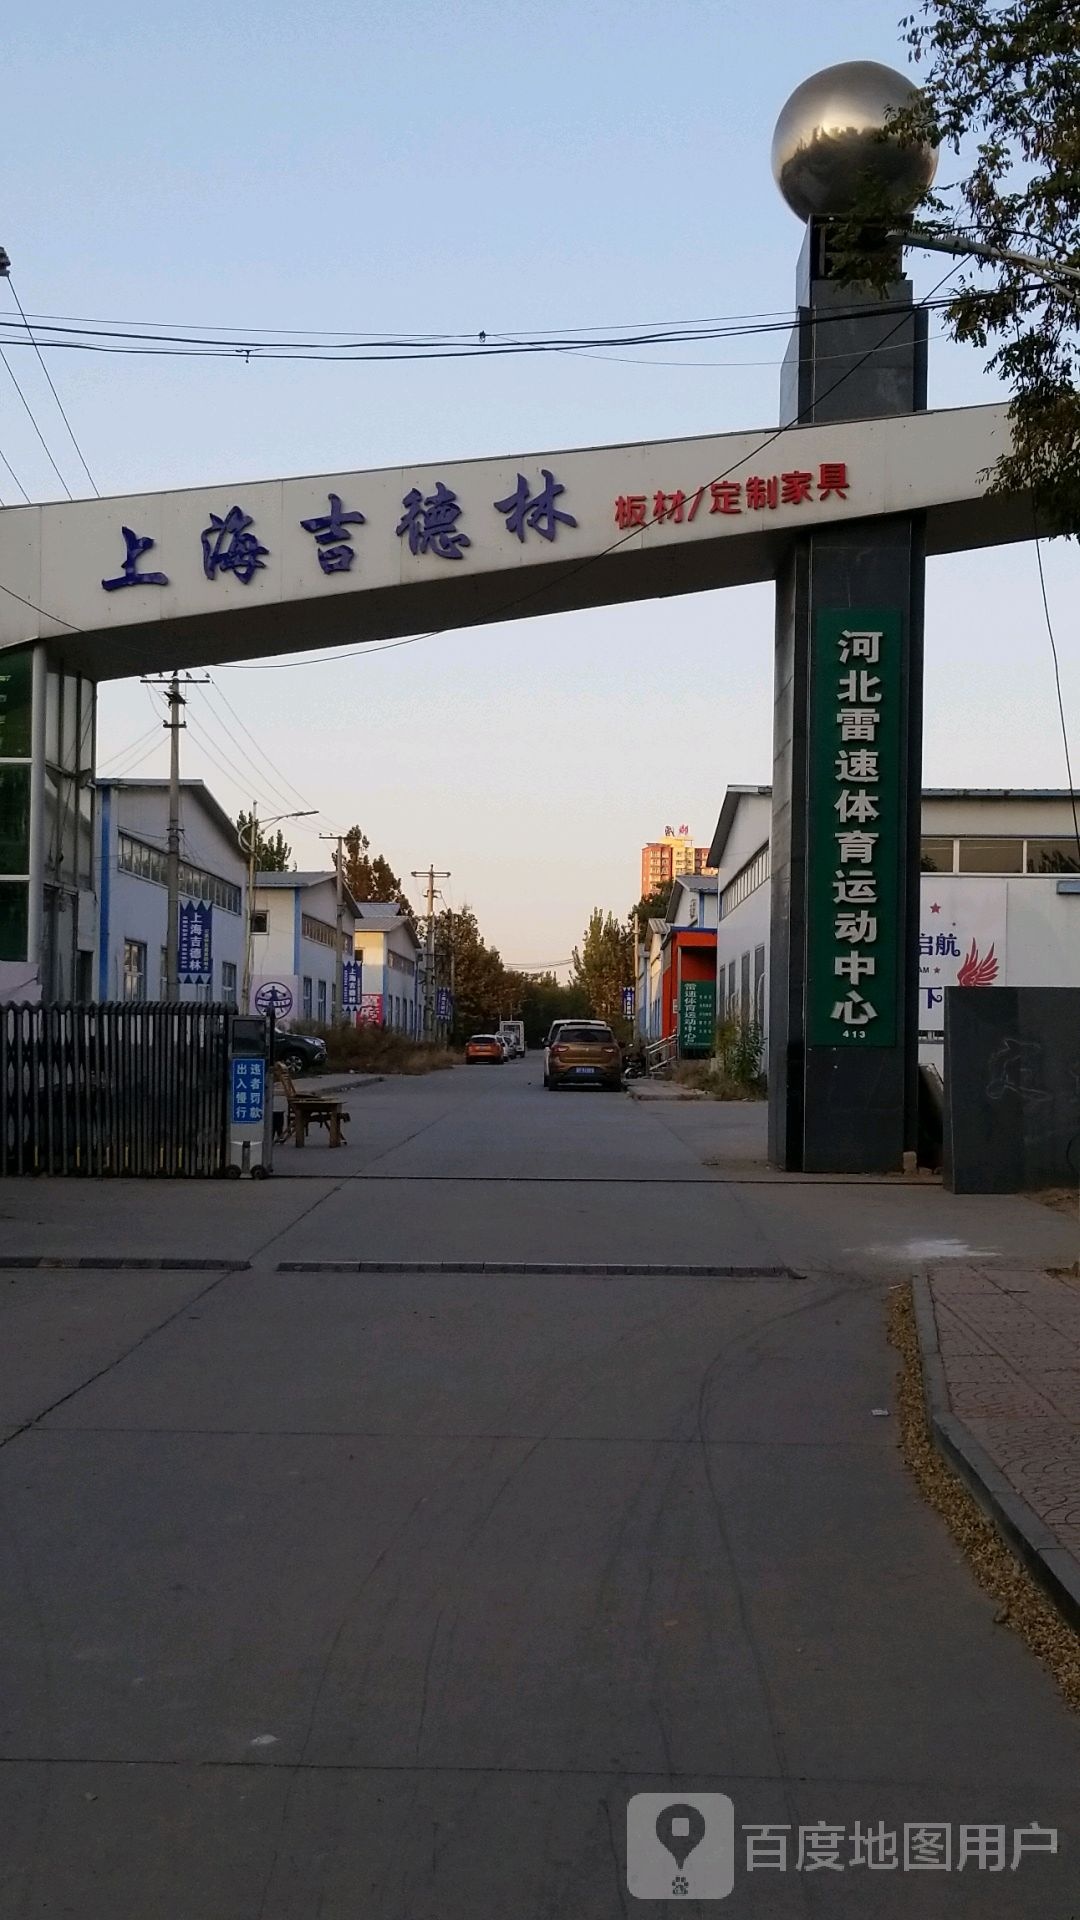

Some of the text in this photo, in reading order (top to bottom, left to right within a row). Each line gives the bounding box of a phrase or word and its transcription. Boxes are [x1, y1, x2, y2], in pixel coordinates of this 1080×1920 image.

[613, 462, 850, 530] 板材/定制家具
[101, 467, 580, 592] 上海吉德林
[830, 630, 884, 1026] 河北雷速体育运动中心
[188, 911, 204, 972] 上海吉德林
[842, 1029, 867, 1039] 413
[236, 1063, 248, 1119] 出入慢行
[249, 1063, 263, 1119] 违者罚款
